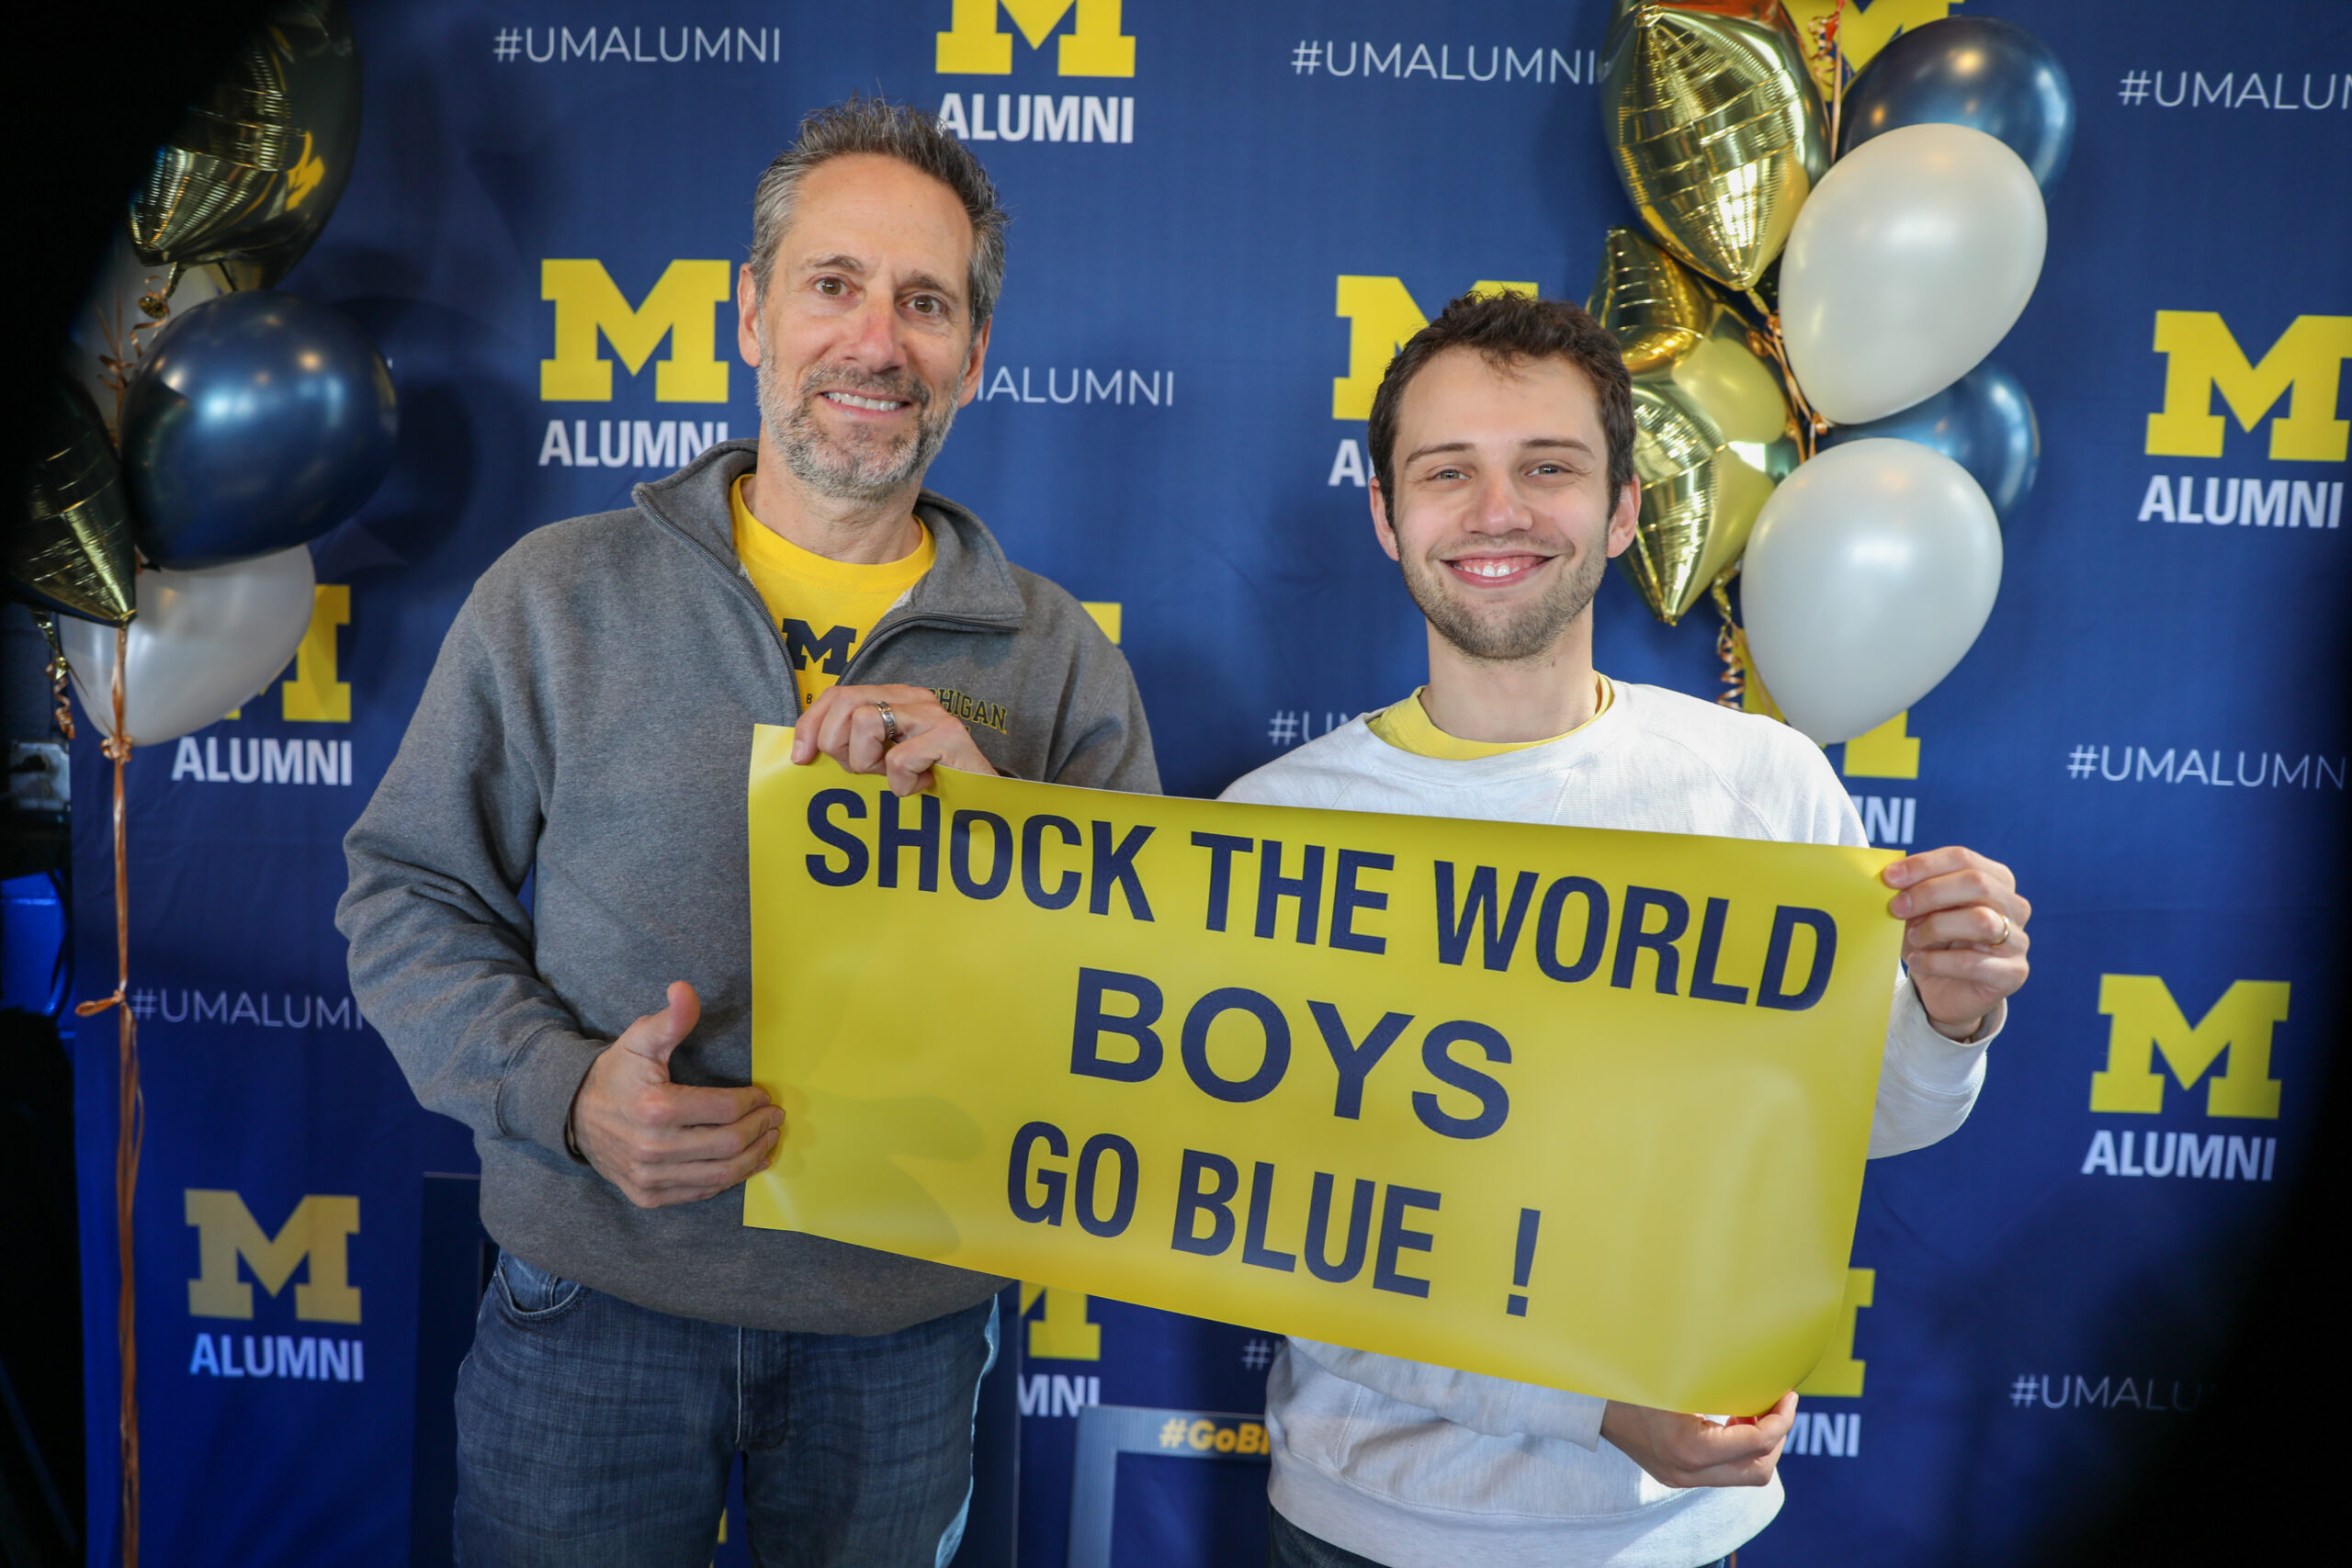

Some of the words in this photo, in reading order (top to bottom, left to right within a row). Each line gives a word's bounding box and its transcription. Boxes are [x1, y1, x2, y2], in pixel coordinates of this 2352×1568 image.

[493, 27, 780, 62] #UMALUMNI
[1291, 39, 1596, 85] #UMALUMNI
[2118, 70, 2352, 110] #UMALU
[936, 93, 1135, 144] ALUMNI
[540, 258, 731, 403] M
[977, 366, 1174, 407] ALUMNI
[2144, 310, 2352, 462] M
[2137, 474, 2345, 529] ALUMNI
[781, 617, 857, 676] M
[930, 688, 1008, 735] HIGAN
[171, 736, 353, 786] ALUMNI
[805, 788, 1156, 922] SHOCK
[1191, 831, 1395, 955] THE
[1433, 860, 1837, 1012] WORLD
[1069, 966, 1512, 1140] BOYS
[2089, 974, 2291, 1120] M
[2080, 1130, 2277, 1181] ALUMNI
[1007, 1121, 1138, 1238] GO
[1171, 1148, 1442, 1298] BLUE
[1506, 1207, 1542, 1318] !
[185, 1188, 361, 1325] M
[188, 1333, 364, 1382] ALUMNI
